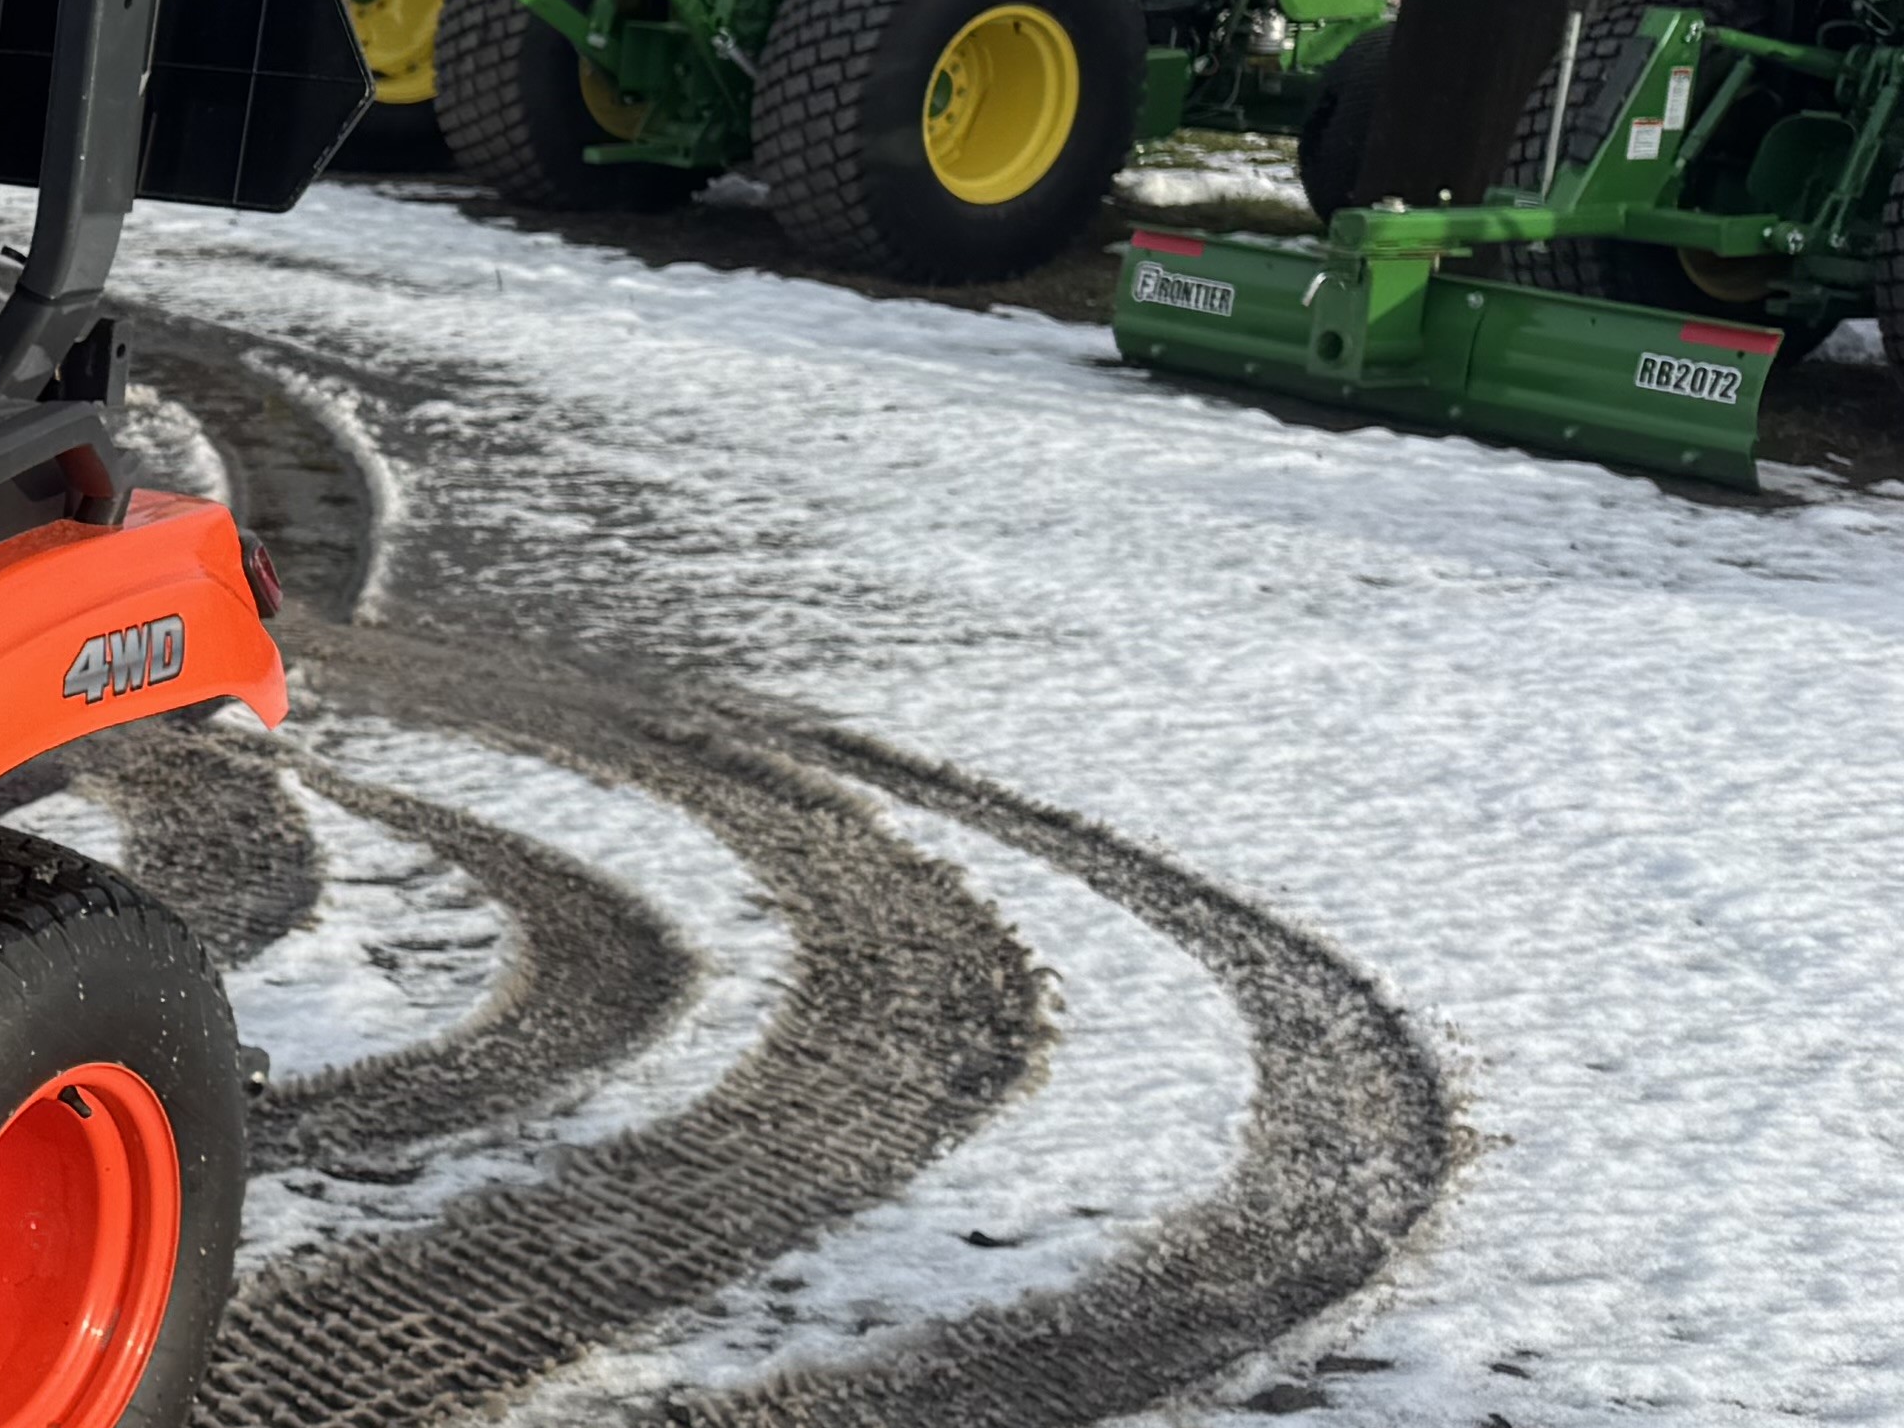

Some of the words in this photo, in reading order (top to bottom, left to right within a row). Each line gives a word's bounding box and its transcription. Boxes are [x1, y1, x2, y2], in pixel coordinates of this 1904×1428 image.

[1133, 261, 1234, 317] FRONTIER
[1638, 356, 1739, 401] RB2072
[62, 612, 186, 705] 4WD
